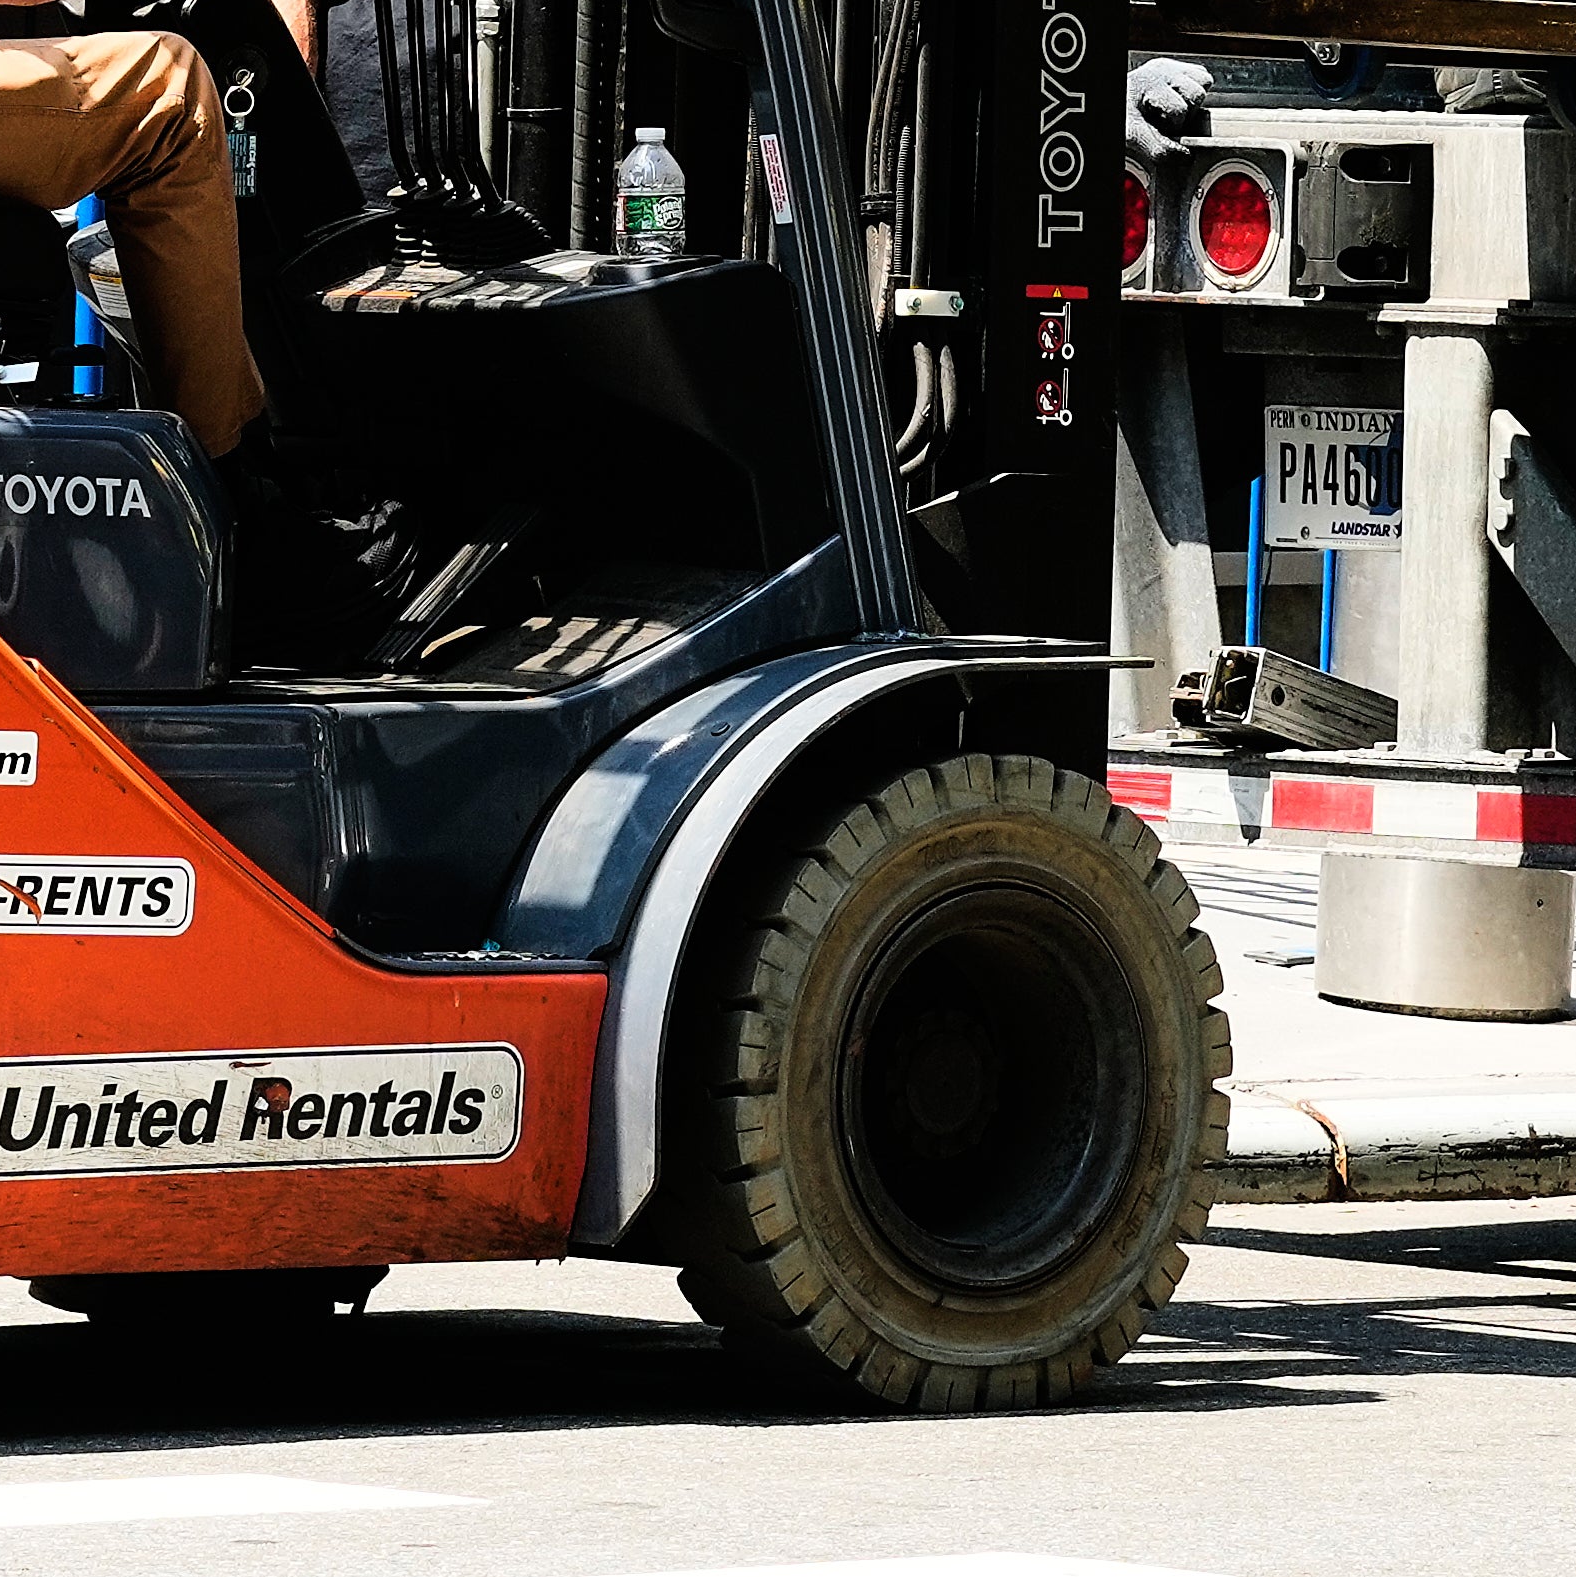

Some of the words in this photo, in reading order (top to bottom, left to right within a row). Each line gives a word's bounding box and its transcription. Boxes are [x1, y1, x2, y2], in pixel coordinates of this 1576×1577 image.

[1316, 411, 1397, 433] INDIAN
[1279, 441, 1403, 509] PA4600
[1331, 521, 1391, 537] LANDSTAR
